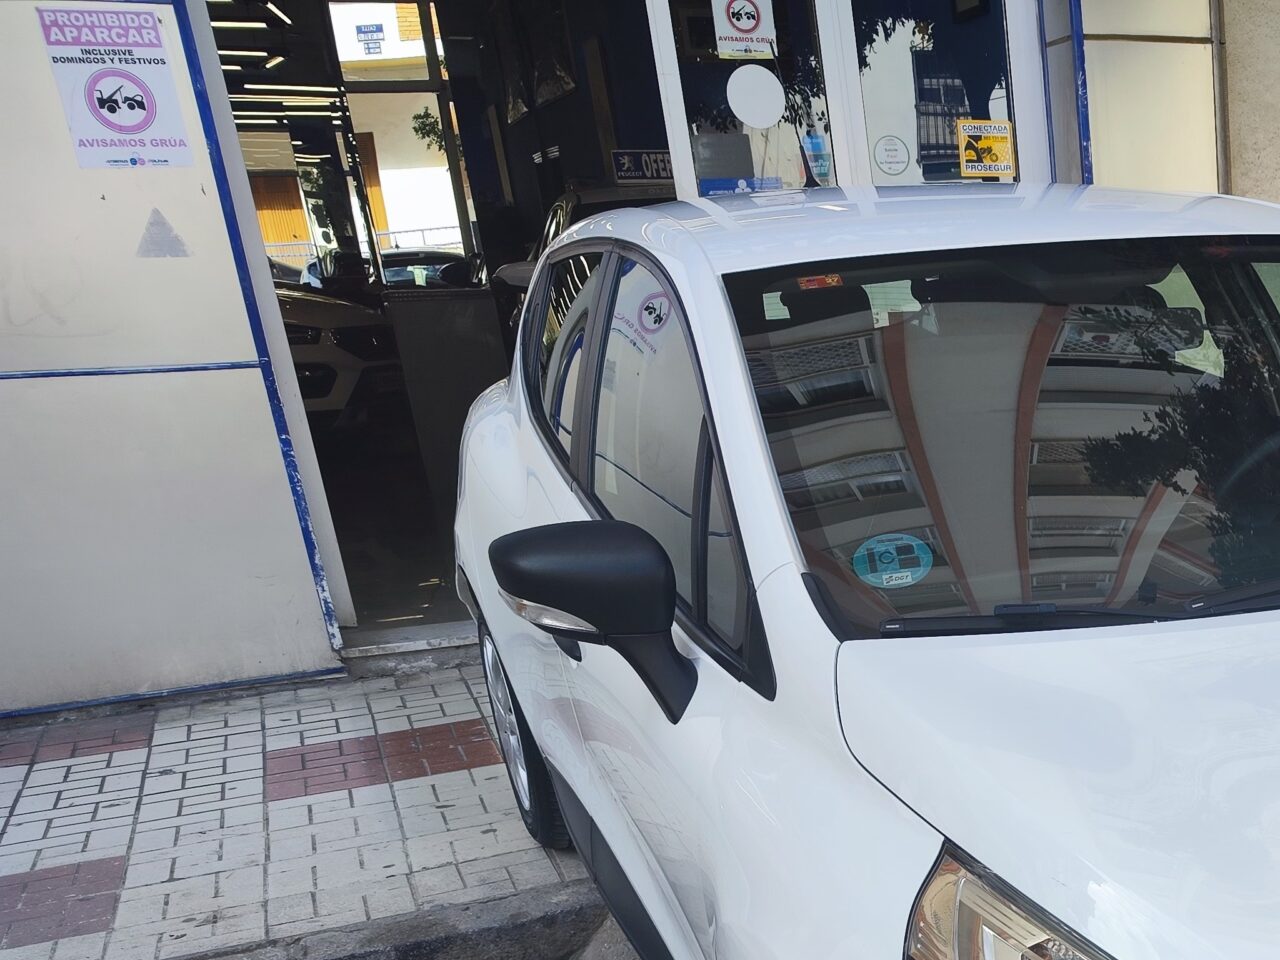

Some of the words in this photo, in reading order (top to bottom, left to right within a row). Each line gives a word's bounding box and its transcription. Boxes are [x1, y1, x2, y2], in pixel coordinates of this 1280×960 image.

[42, 11, 154, 28] PROHIBIDO
[50, 27, 160, 44] APARCAR
[718, 35, 755, 44] AVISAMOS
[80, 48, 135, 57] INCLUSIVE
[52, 56, 107, 64] DOMINGOS
[118, 57, 167, 66] FESTIVOS
[962, 124, 1009, 132] CONECTADA
[78, 138, 147, 149] AVISAMOS
[150, 136, 188, 148] GRÚA
[965, 164, 1012, 172] PROSEGUR
